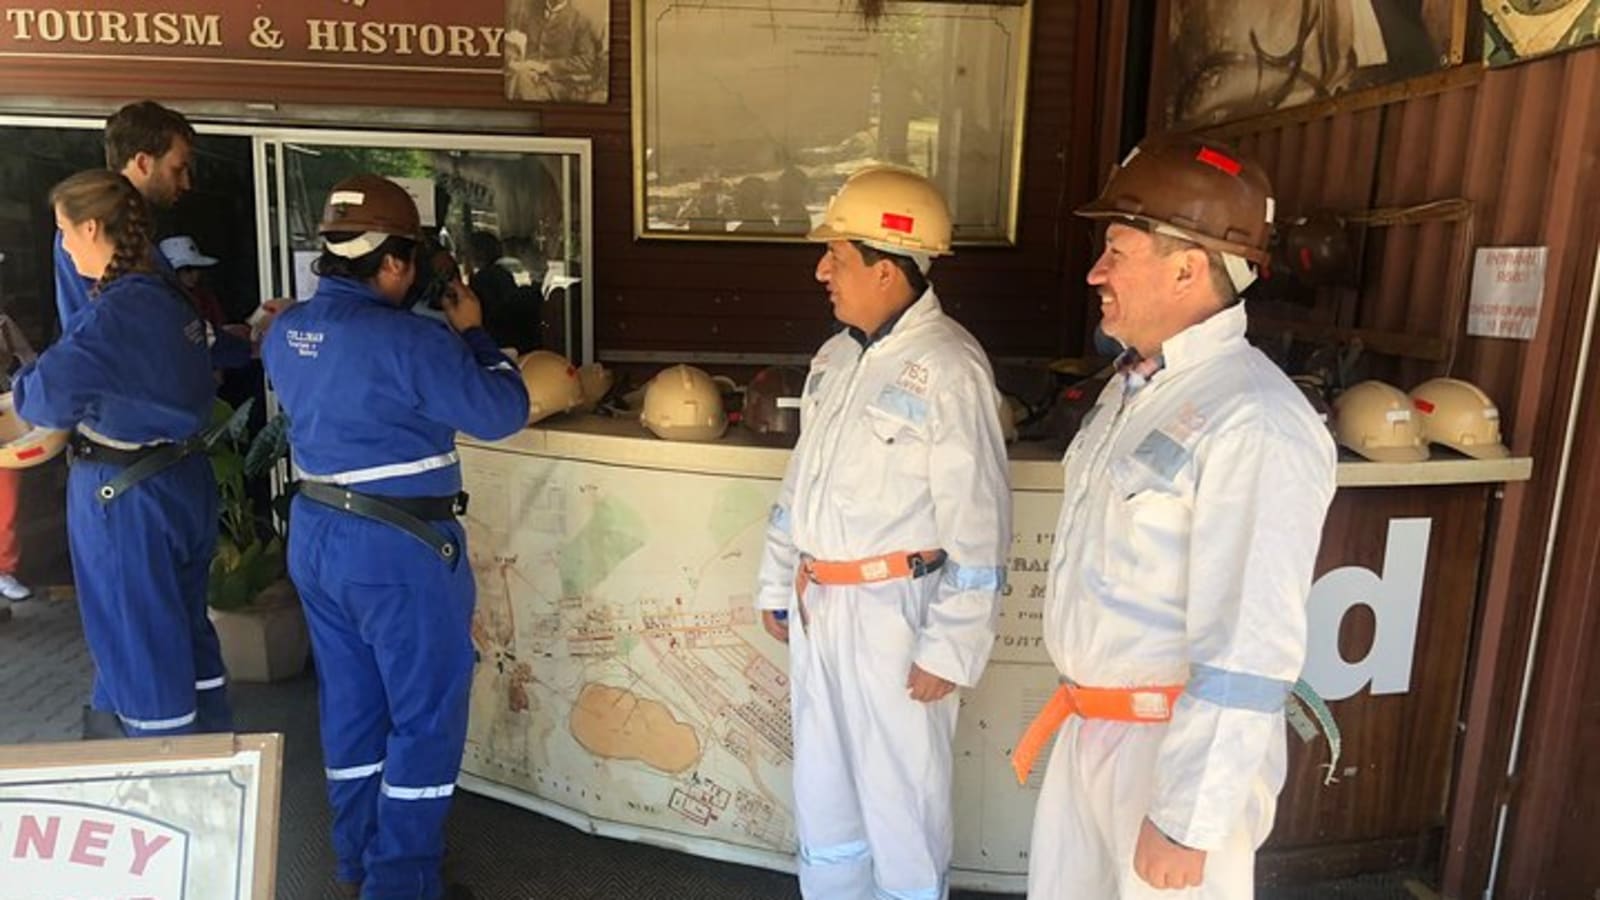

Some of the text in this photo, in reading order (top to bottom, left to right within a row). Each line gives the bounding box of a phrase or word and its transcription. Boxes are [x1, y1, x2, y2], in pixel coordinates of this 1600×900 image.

[7, 9, 505, 58] TOURISM & HISTORY
[1299, 517, 1433, 701] d
[0, 815, 172, 877] NEY
